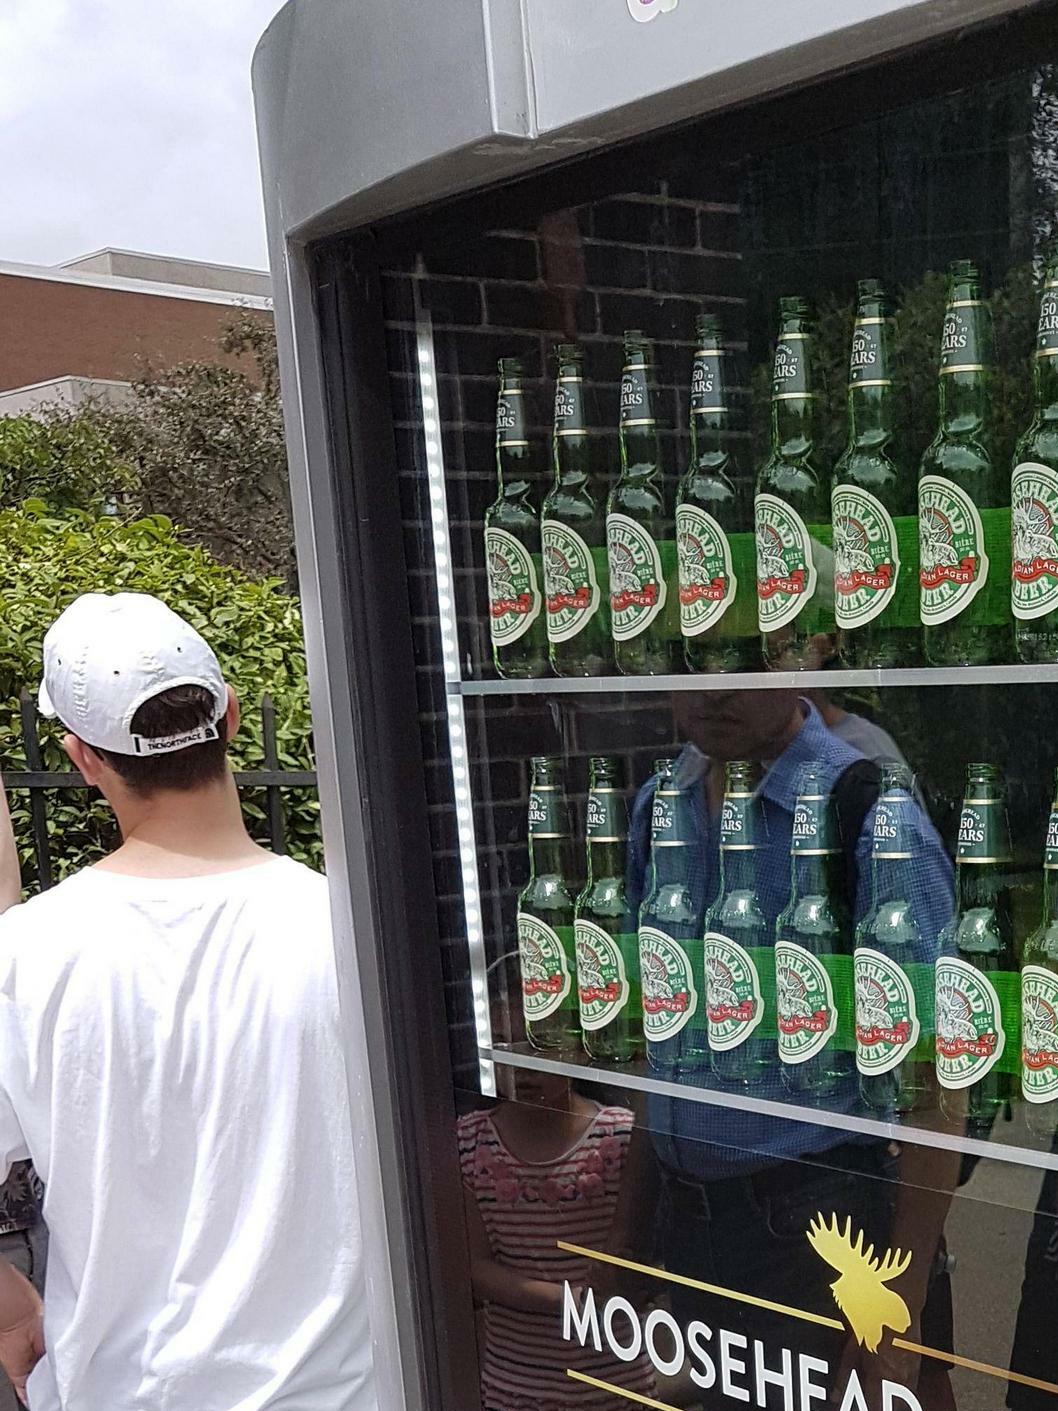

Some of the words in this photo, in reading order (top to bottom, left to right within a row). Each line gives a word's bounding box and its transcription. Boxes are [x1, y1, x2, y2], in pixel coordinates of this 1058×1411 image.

[851, 350, 875, 364] EARS
[855, 576, 885, 585] LAGER
[938, 570, 968, 580] LAGER
[771, 582, 799, 591] LAGER
[793, 825, 816, 836] EARS
[959, 829, 984, 842] EARS
[795, 1019, 822, 1030] LAGER
[874, 1030, 902, 1041] LAGER
[958, 1044, 987, 1054] LAGER
